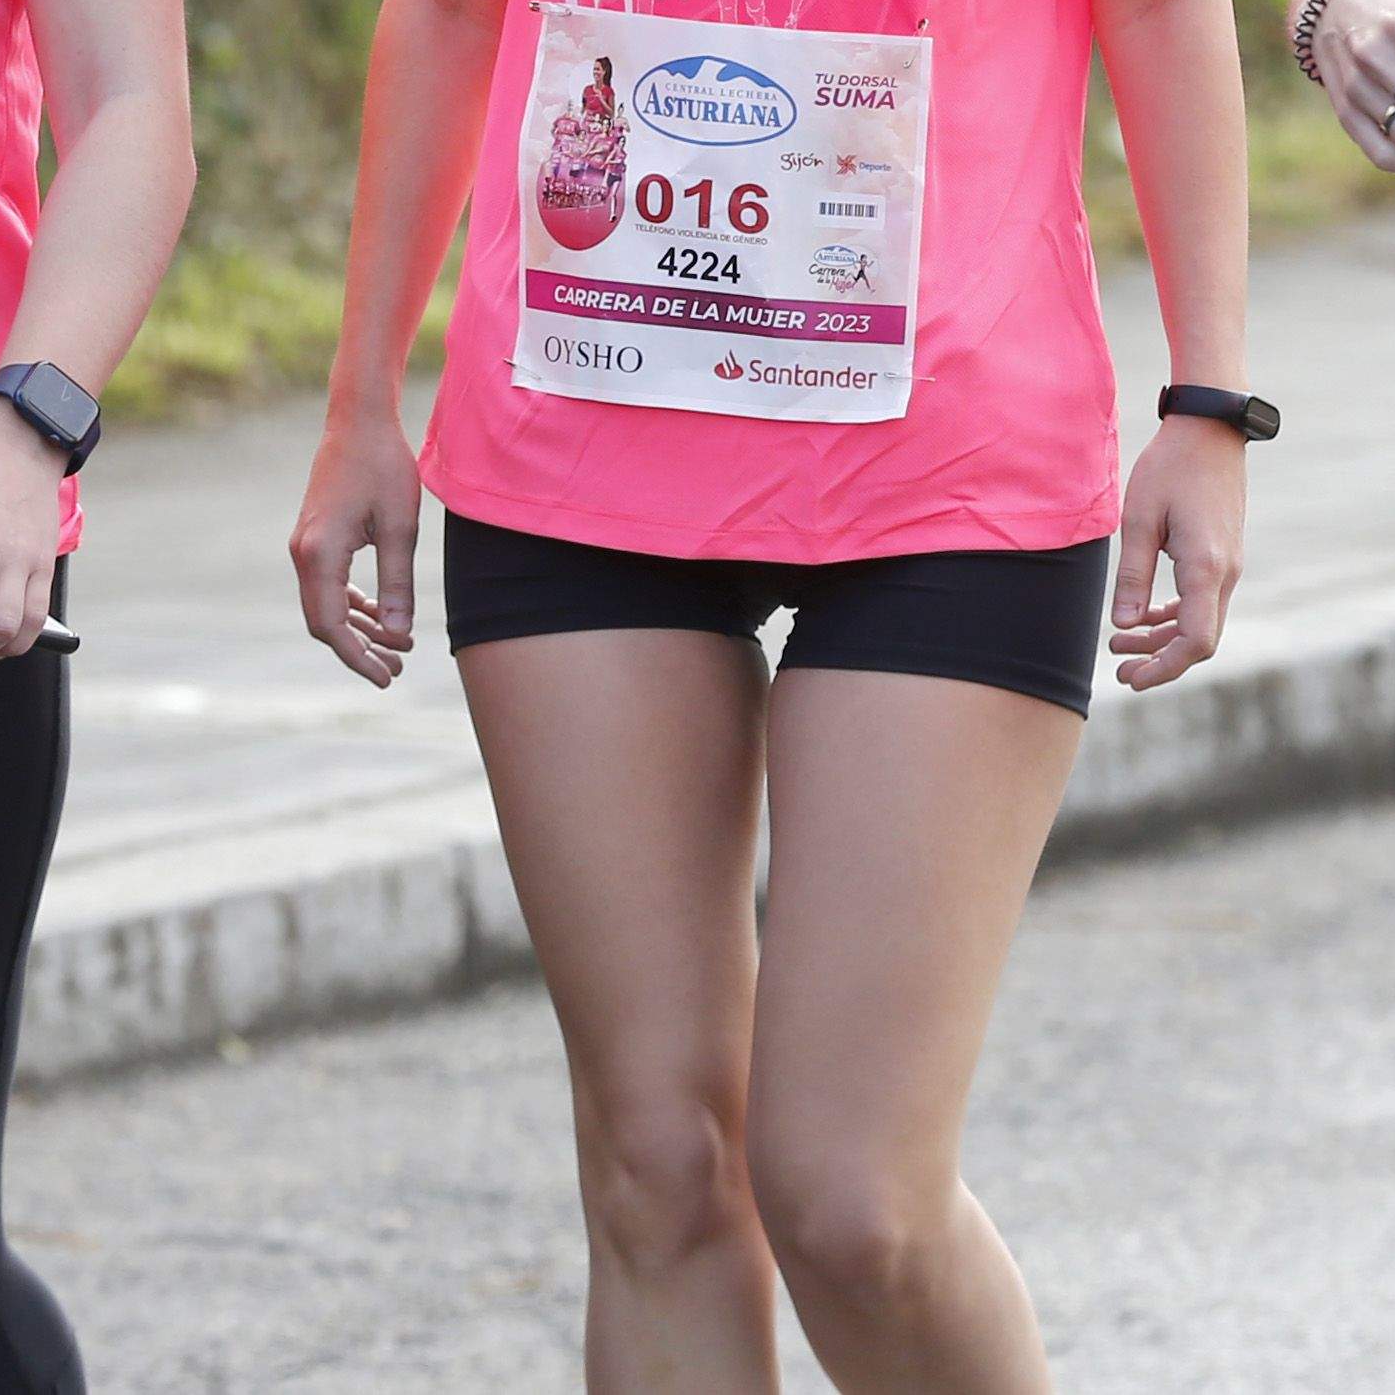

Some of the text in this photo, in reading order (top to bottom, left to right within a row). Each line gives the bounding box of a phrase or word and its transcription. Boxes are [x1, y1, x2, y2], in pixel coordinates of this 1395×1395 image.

[665, 83, 777, 101] CENTRAL LECHERA
[815, 73, 898, 88] TU DORSAL
[643, 82, 782, 127] ASTURIANA
[814, 87, 895, 109] SUMA
[859, 162, 891, 172] Deporte
[635, 173, 770, 235] 016
[677, 228, 718, 241] VIOLENCIA
[720, 234, 731, 242] DE
[657, 246, 741, 284] 4224
[554, 284, 871, 334] CARRERA DE LA MUJER 2023
[544, 335, 644, 374] OYSHO
[748, 360, 877, 390] Santander
